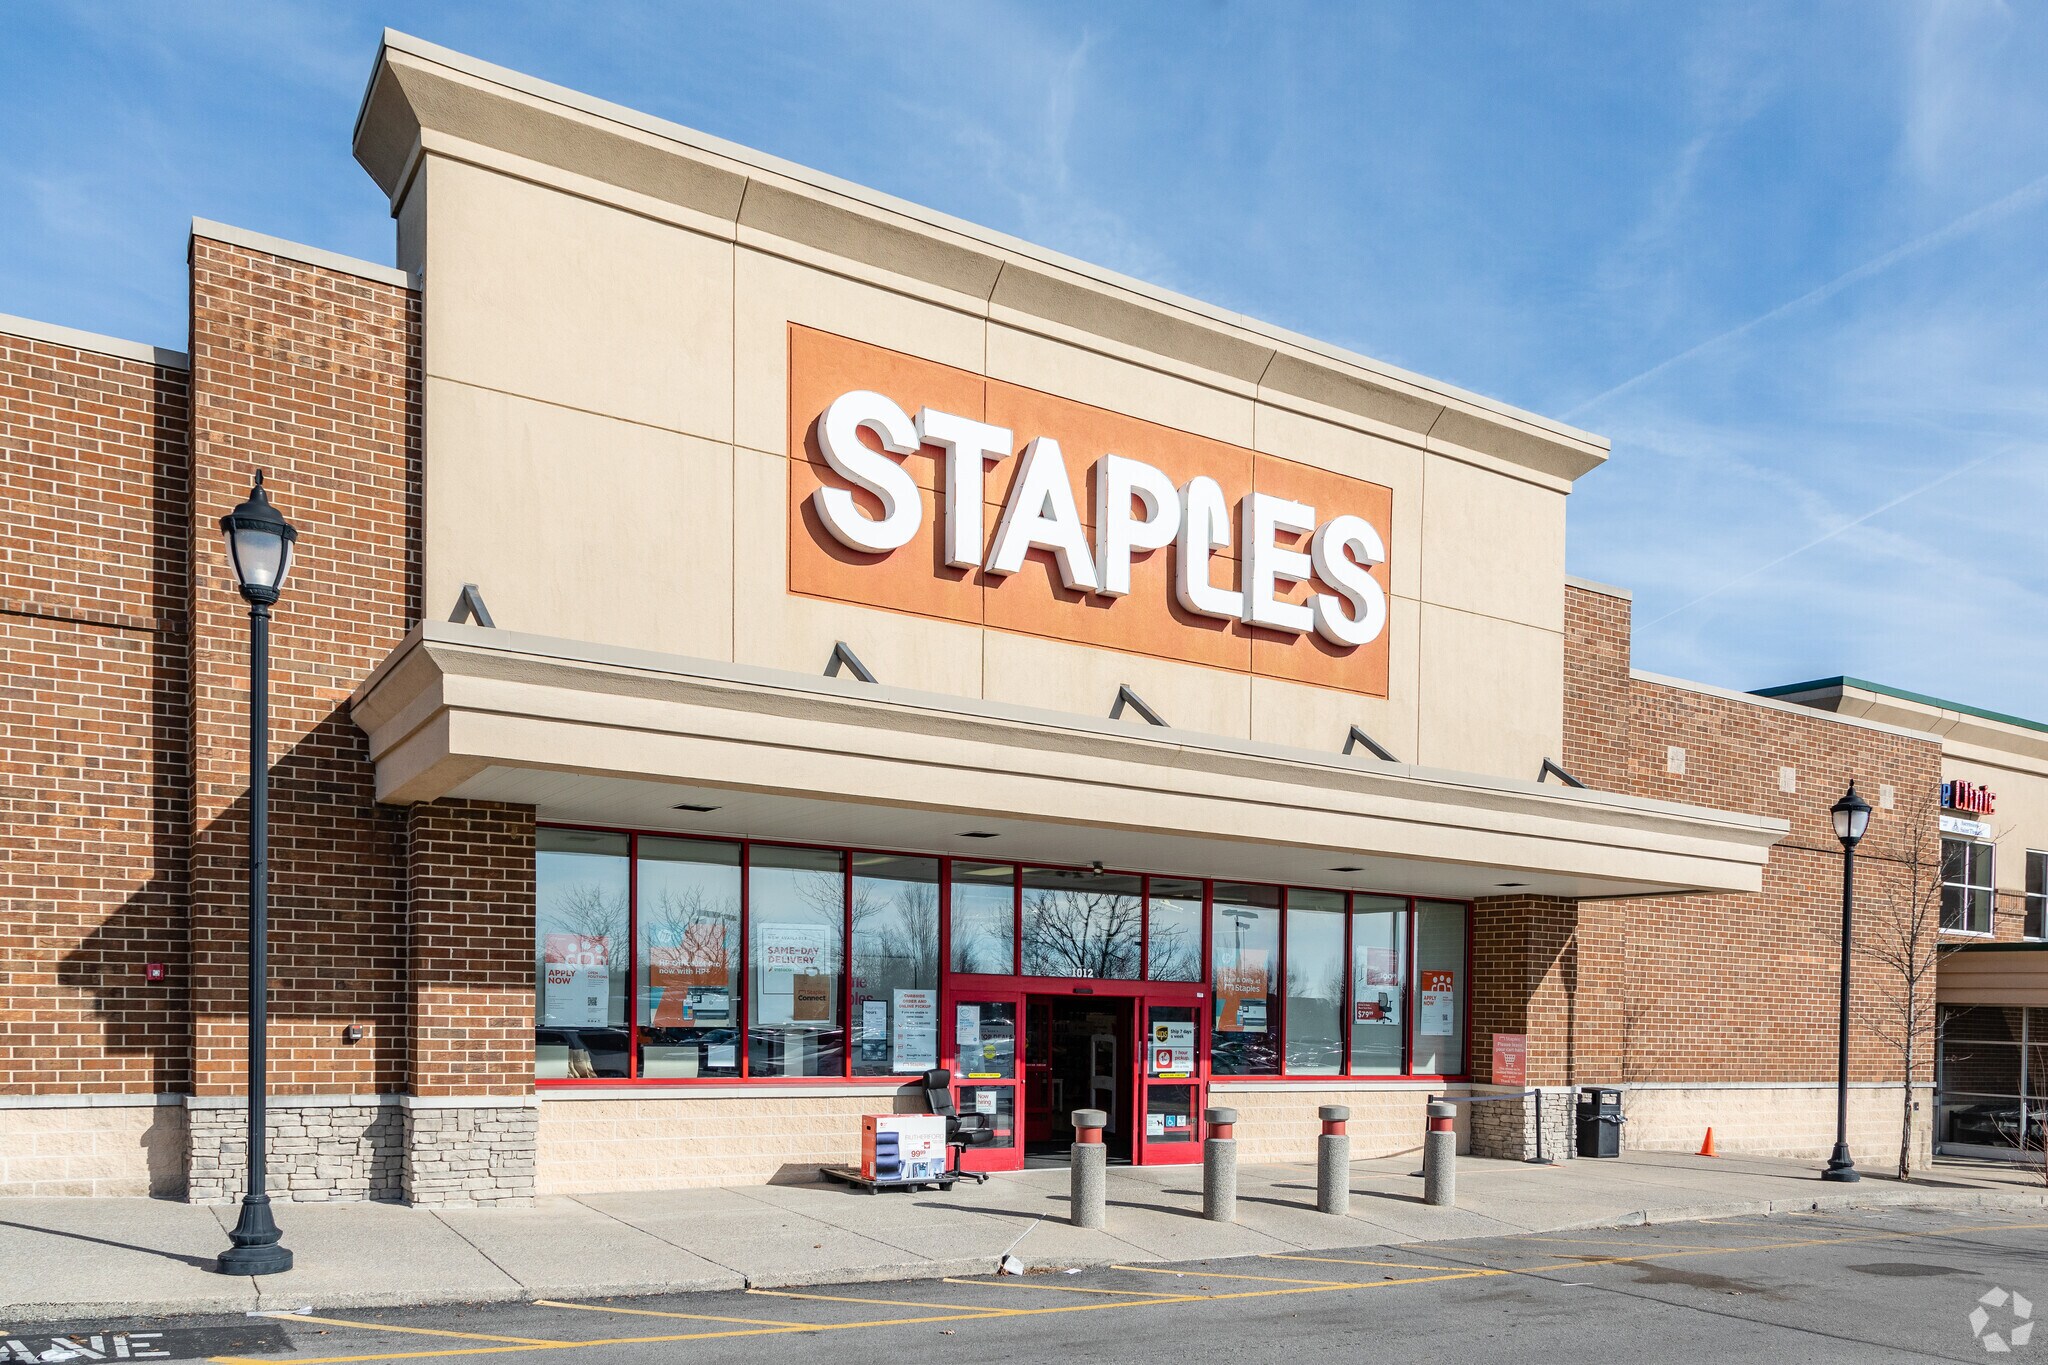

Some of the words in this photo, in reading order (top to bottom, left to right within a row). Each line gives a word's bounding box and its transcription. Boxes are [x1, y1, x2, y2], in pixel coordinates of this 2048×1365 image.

[813, 390, 1387, 646] STAPLES
[1952, 779, 1996, 815] Clinic
[767, 946, 819, 955] SAME-DAY
[768, 955, 815, 964] DELIVERY
[548, 969, 576, 977] APPLY
[1072, 968, 1093, 978] 1012
[1235, 985, 1260, 993] Staples
[905, 1133, 944, 1141] RUTHERFORD
